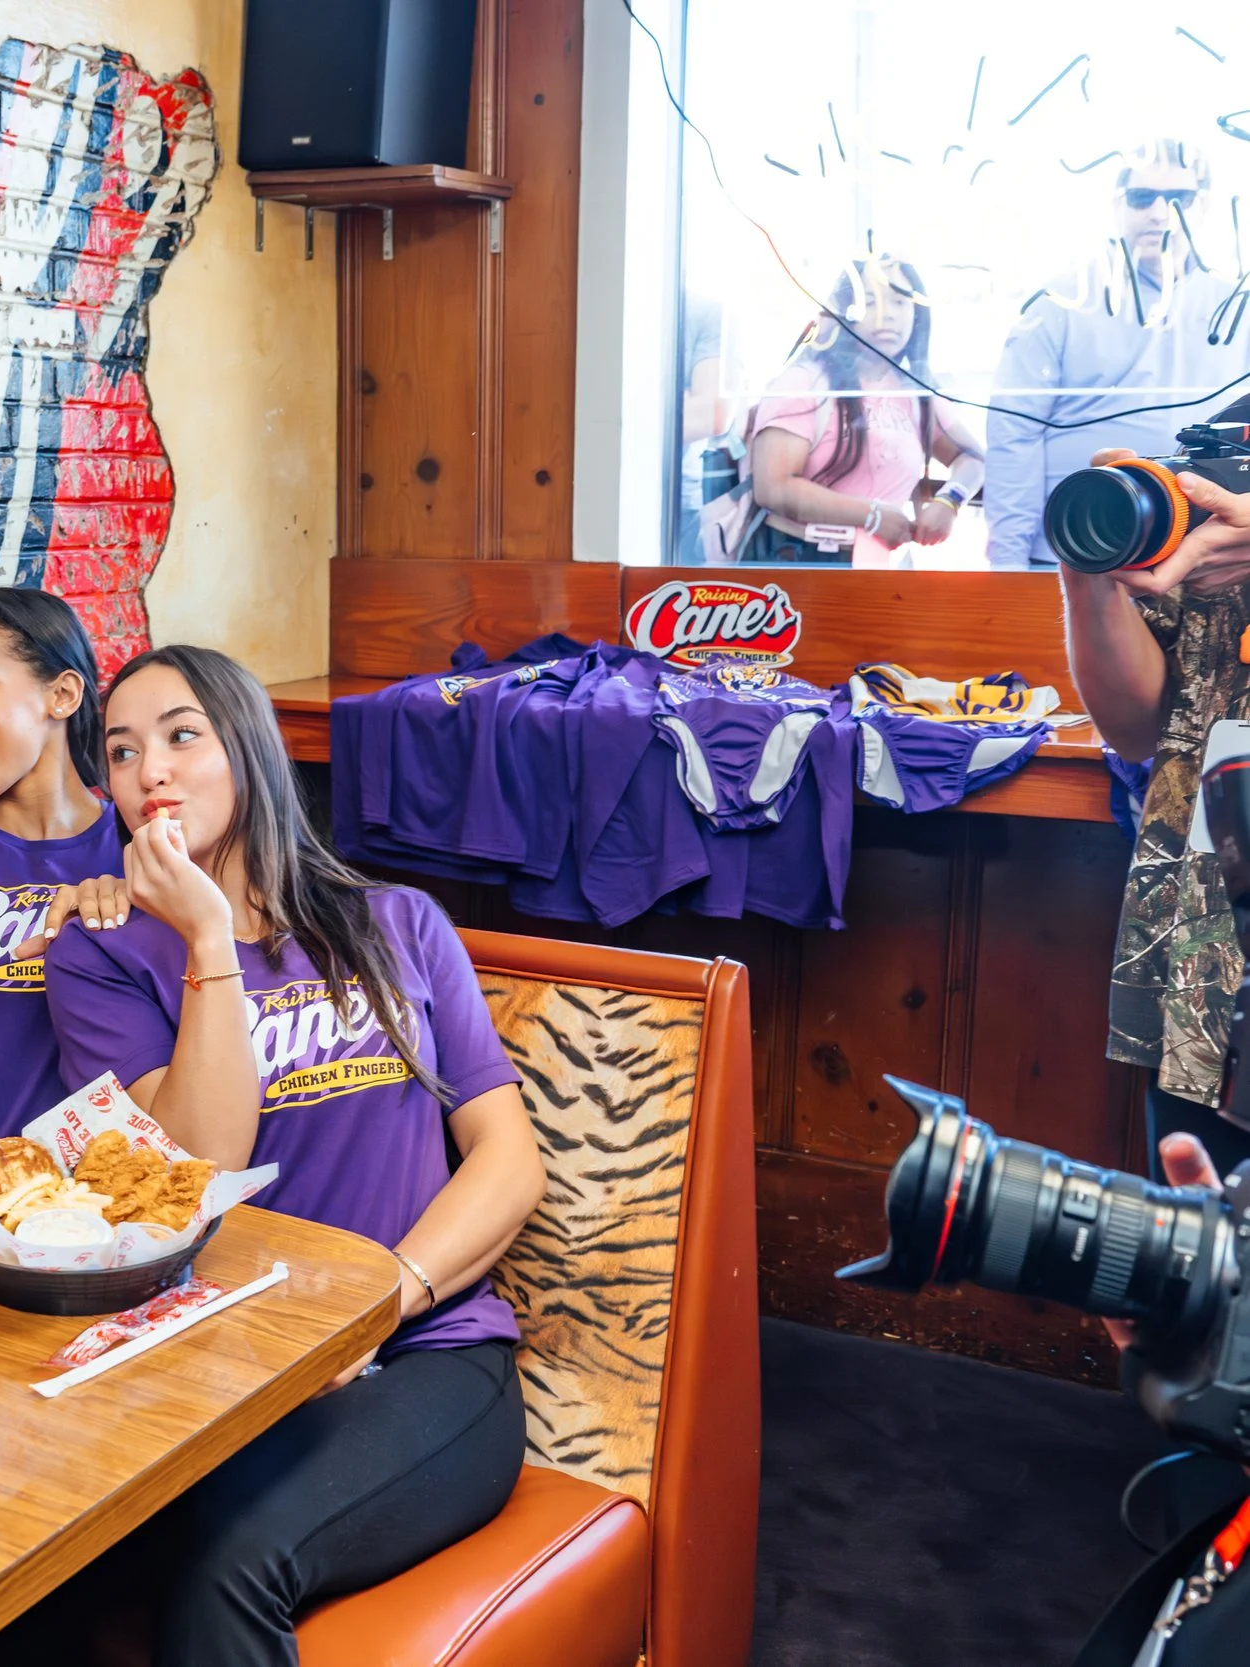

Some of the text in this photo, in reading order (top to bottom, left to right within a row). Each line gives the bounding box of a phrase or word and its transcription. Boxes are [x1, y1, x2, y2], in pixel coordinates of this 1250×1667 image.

[692, 587, 749, 606] Raising
[636, 583, 798, 659] Cane's
[14, 890, 57, 909] Rais
[278, 1062, 404, 1093] CHICKEN FINGERS
[126, 1113, 159, 1136] LOVE
